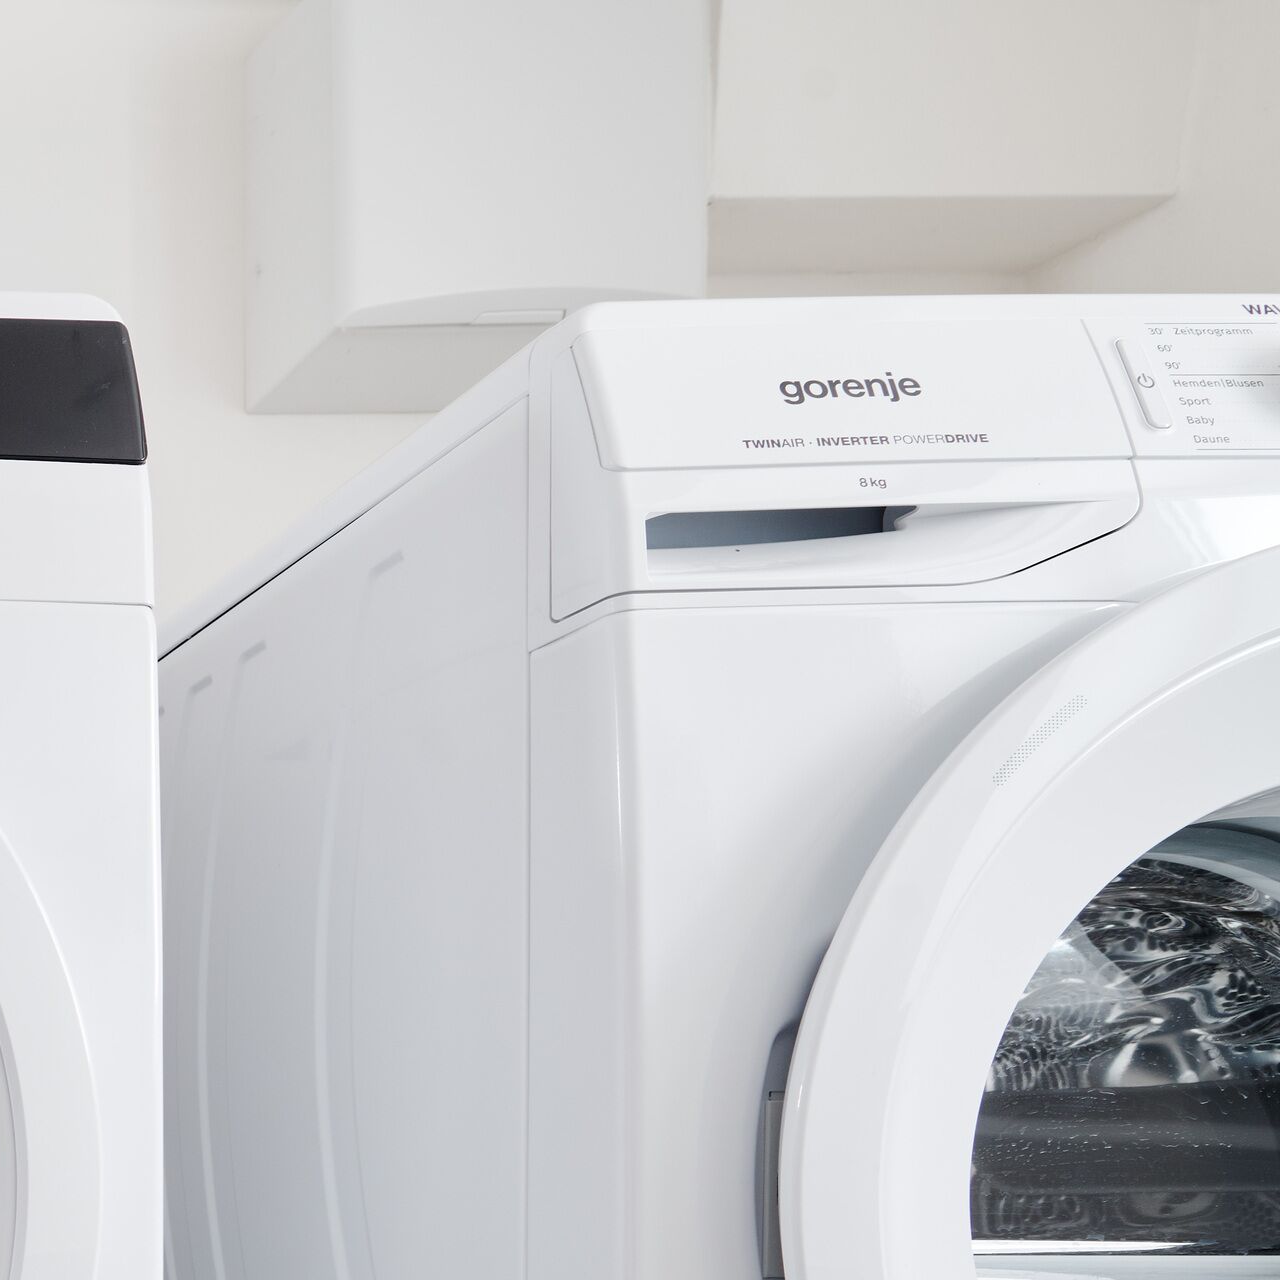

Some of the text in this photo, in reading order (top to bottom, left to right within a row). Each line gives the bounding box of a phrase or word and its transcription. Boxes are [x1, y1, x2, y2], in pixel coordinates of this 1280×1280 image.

[1173, 327, 1254, 337] Zeitprogramm
[779, 371, 922, 405] gorenje
[1178, 397, 1212, 407] Sport
[1186, 416, 1215, 426] Baby
[742, 433, 990, 449] TWINAIR INVERTER POWERDRIVE
[1193, 435, 1231, 444] Daune
